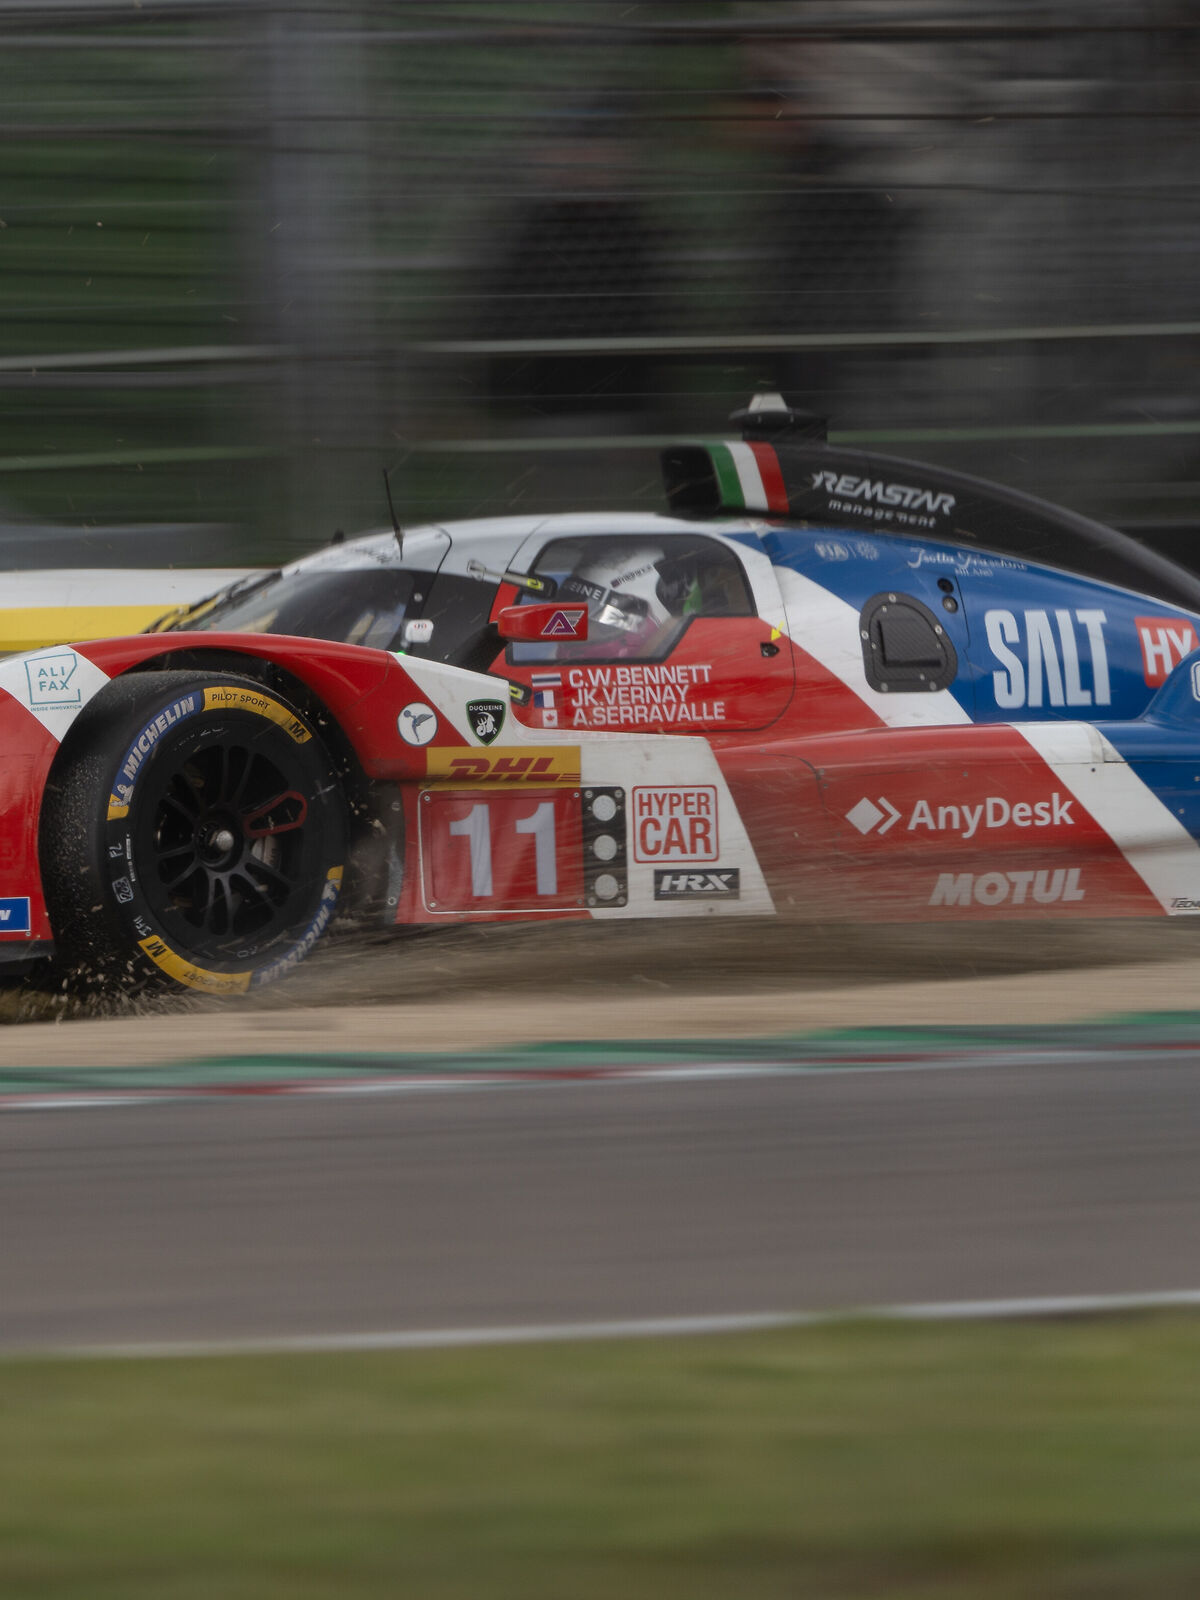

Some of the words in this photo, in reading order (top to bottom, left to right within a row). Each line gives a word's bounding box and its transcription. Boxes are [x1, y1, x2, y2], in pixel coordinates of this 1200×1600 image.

[814, 471, 956, 515] REMSTAR
[828, 499, 937, 528] management
[984, 609, 1111, 709] SALT
[38, 666, 65, 678] ALI
[569, 665, 712, 688] C.W.BENNETT
[39, 680, 69, 692] FAX
[571, 685, 689, 707] JK.VERNAY
[212, 693, 238, 701] PILOT
[240, 694, 270, 710] SPORT
[469, 704, 504, 712] DUQUEINE
[573, 701, 726, 727] A.SERRAVALLE
[123, 696, 195, 781] MICHELIN
[449, 757, 561, 782] DHL
[638, 792, 711, 816] HYPER
[907, 792, 1075, 839] AnyDesk
[640, 817, 712, 856] CAR
[450, 802, 557, 897] 11
[660, 874, 733, 891] HRX
[928, 868, 1086, 906] MOTUL
